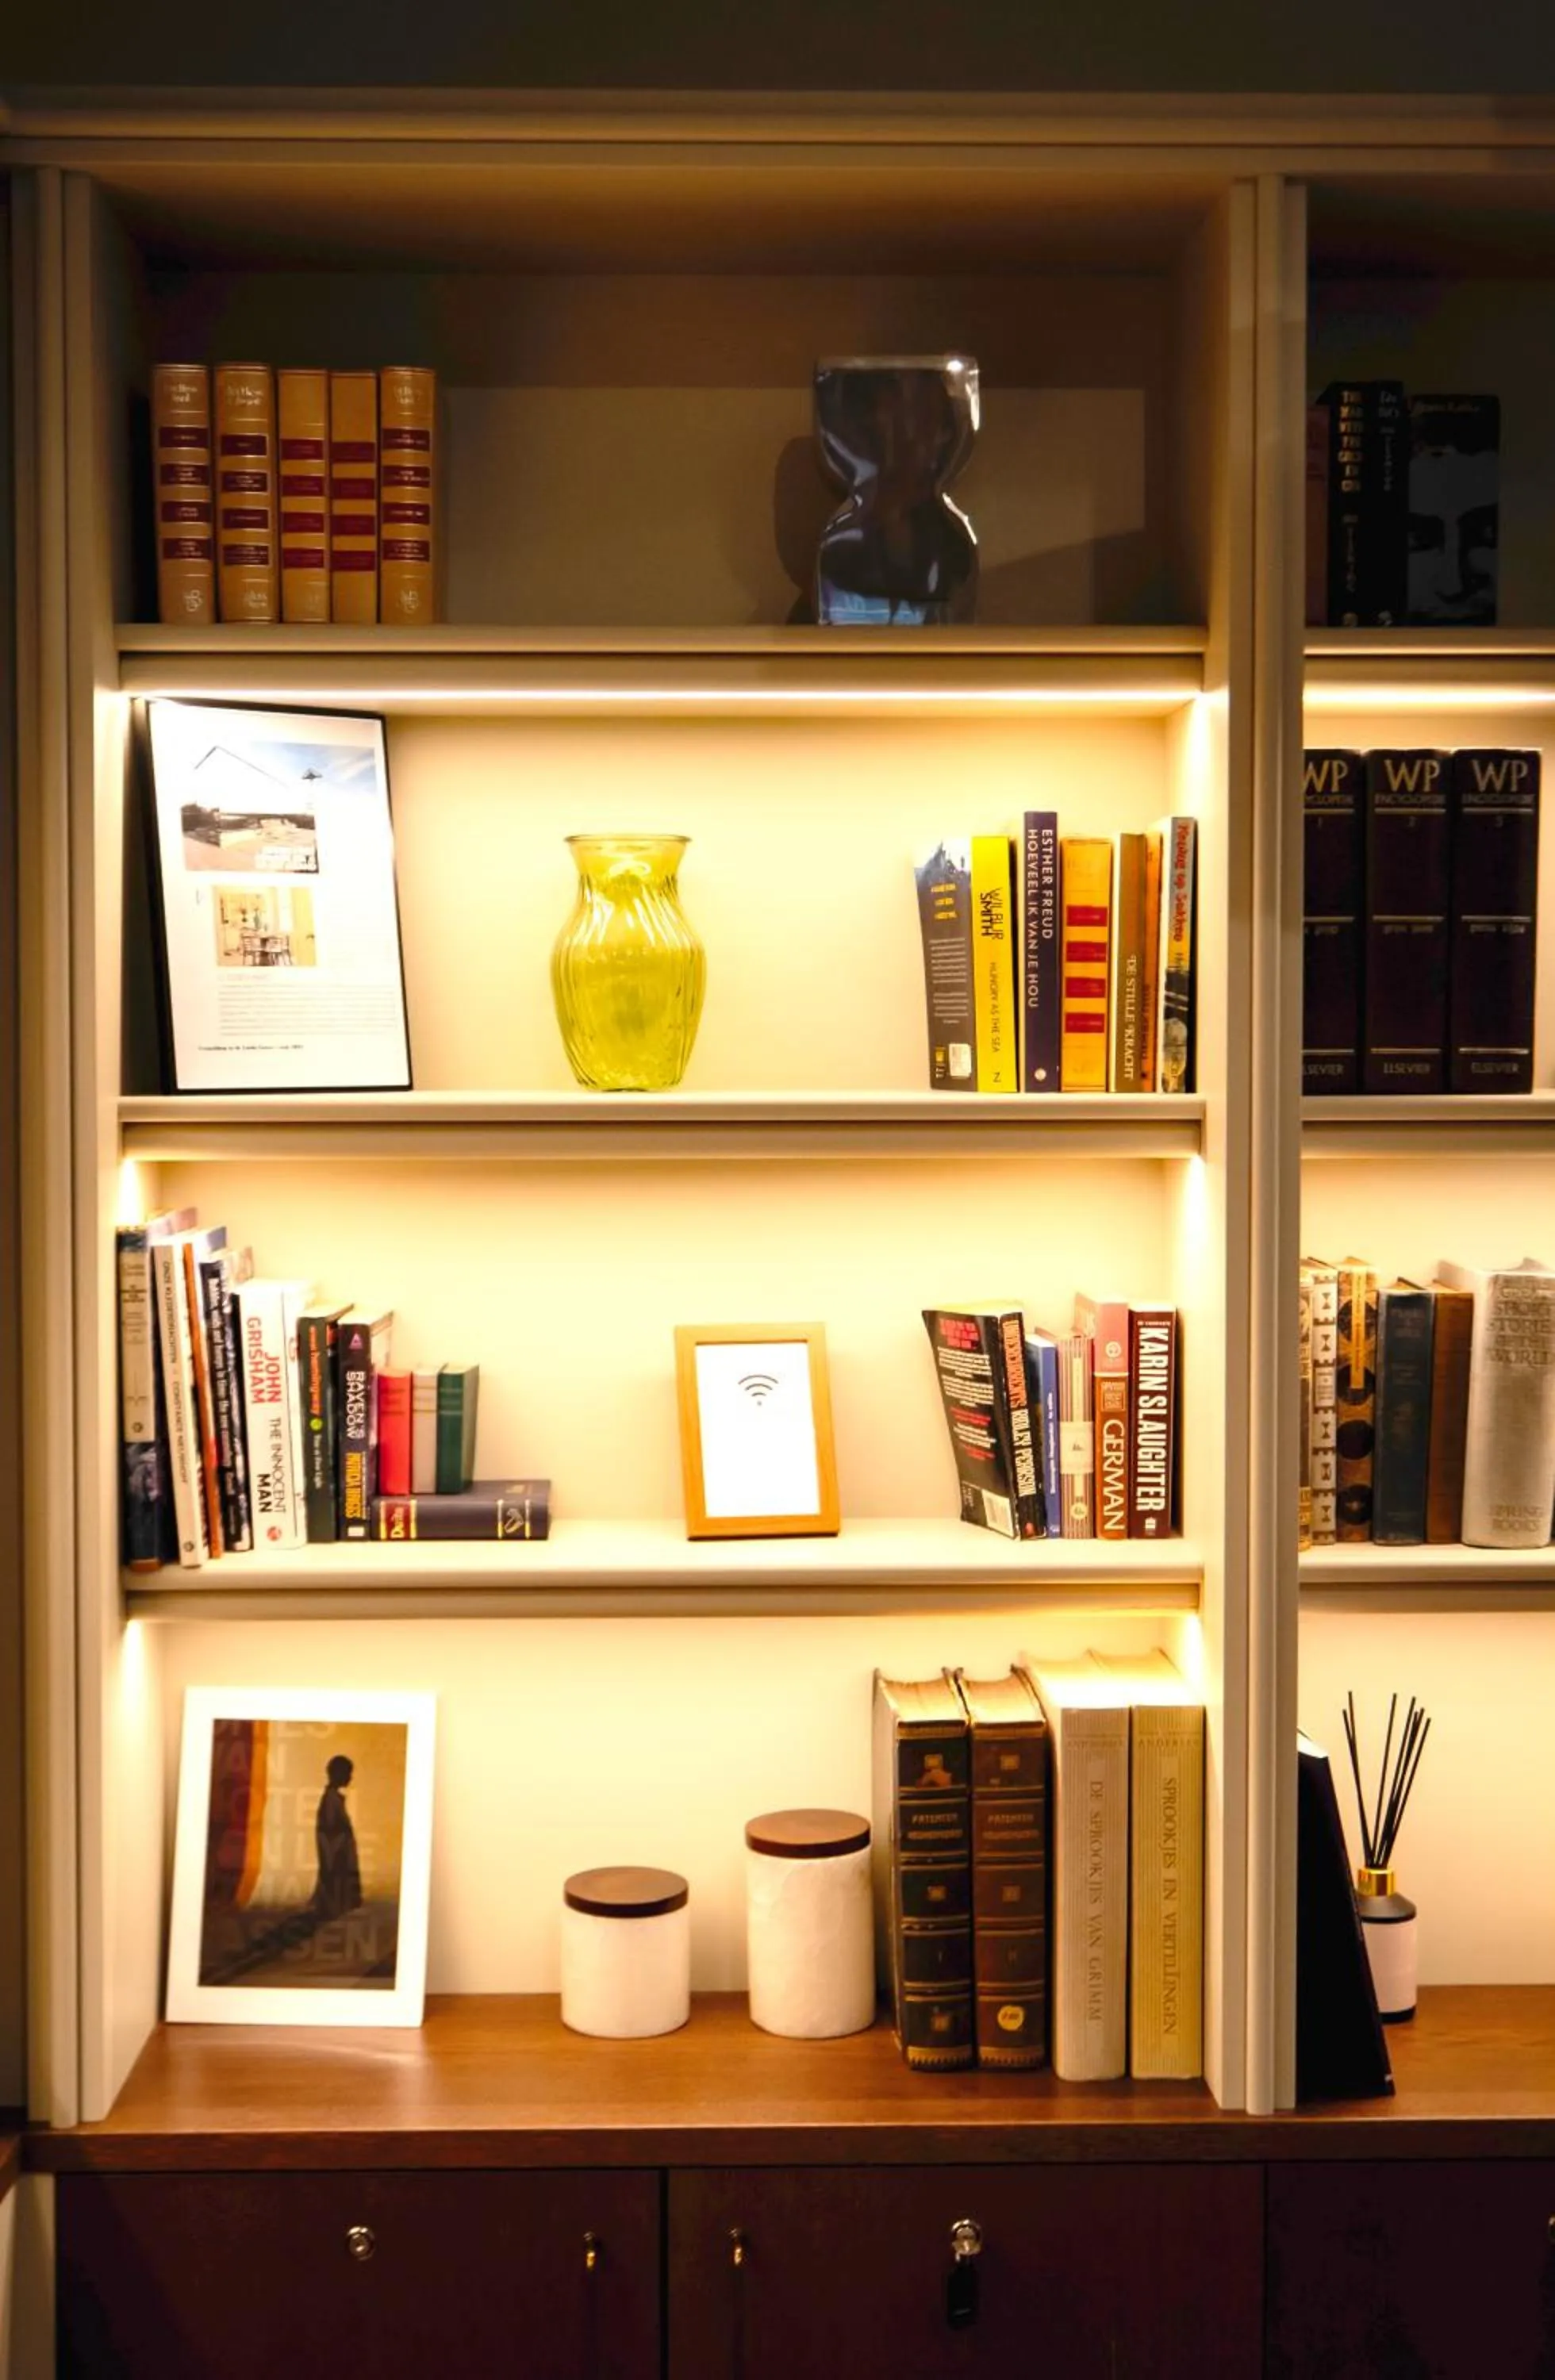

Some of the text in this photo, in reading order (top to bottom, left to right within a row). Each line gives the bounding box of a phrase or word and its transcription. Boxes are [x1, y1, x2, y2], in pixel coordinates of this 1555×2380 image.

[1304, 758, 1350, 793] WP
[1384, 758, 1441, 793] WP
[1472, 758, 1529, 793] WP
[980, 892, 994, 936] SMITH
[1042, 829, 1054, 939] ESTHER FREUD
[1027, 829, 1039, 1008] HOEVEEL IK VAN JE HOU
[989, 962, 1000, 1053] HUNGRY AS THE SEA
[1125, 977, 1136, 1023] STILLE
[1123, 1024, 1135, 1081] KRACHT
[1383, 1062, 1432, 1075] ELSEVIER
[1471, 1062, 1520, 1074] ELSEVIER
[246, 1315, 263, 1405] GRISHAM
[264, 1351, 282, 1403] JOHN
[1137, 1327, 1170, 1391] KARIN
[345, 1371, 357, 1439] SHADOW
[268, 1417, 287, 1514] THE INNOCENT
[1102, 1420, 1126, 1532] GERMAN
[1135, 1392, 1168, 1512] SLAUGHTER
[255, 1472, 273, 1514] MAN
[1088, 1780, 1104, 2021] DE SPROOKJES VAN GRIMM
[1159, 1776, 1180, 2035] SPROOKJES EN VERTELLINGEN
